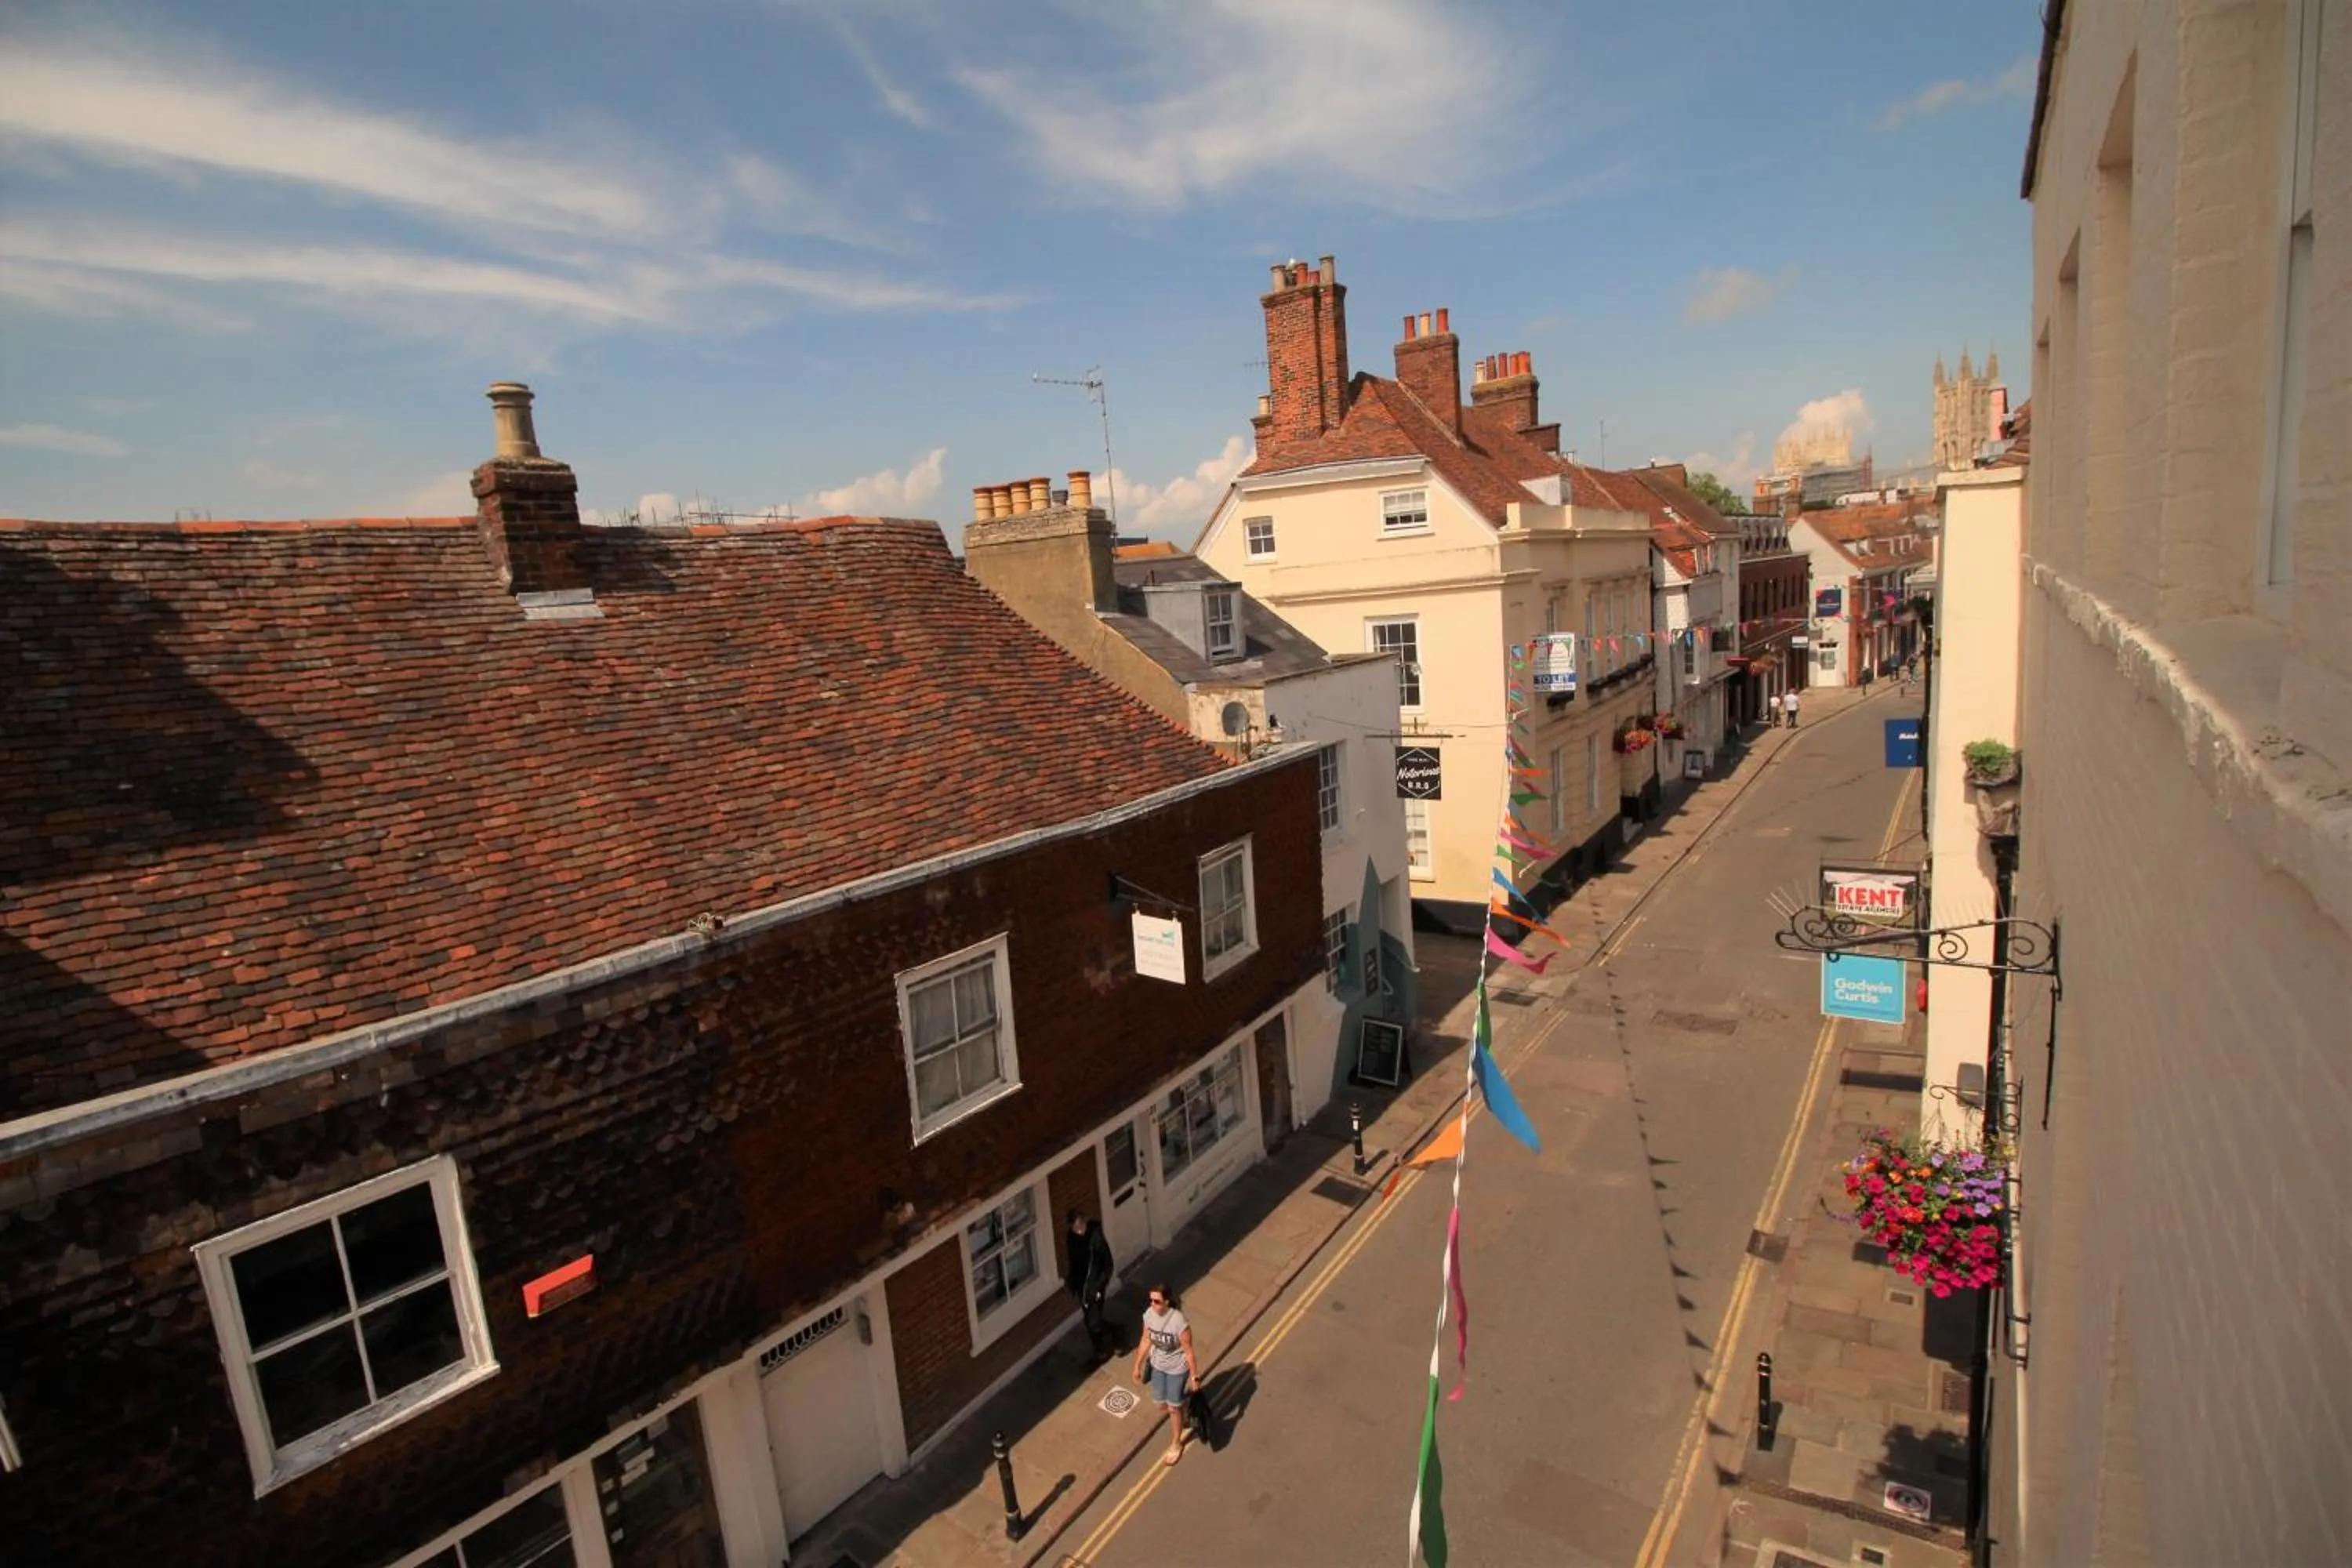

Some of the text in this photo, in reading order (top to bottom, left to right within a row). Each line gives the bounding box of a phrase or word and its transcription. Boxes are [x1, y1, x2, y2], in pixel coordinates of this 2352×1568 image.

[1838, 887, 1900, 906] KENT
[1835, 978, 1893, 995] Godwin
[1835, 989, 1880, 1004] Curtis
